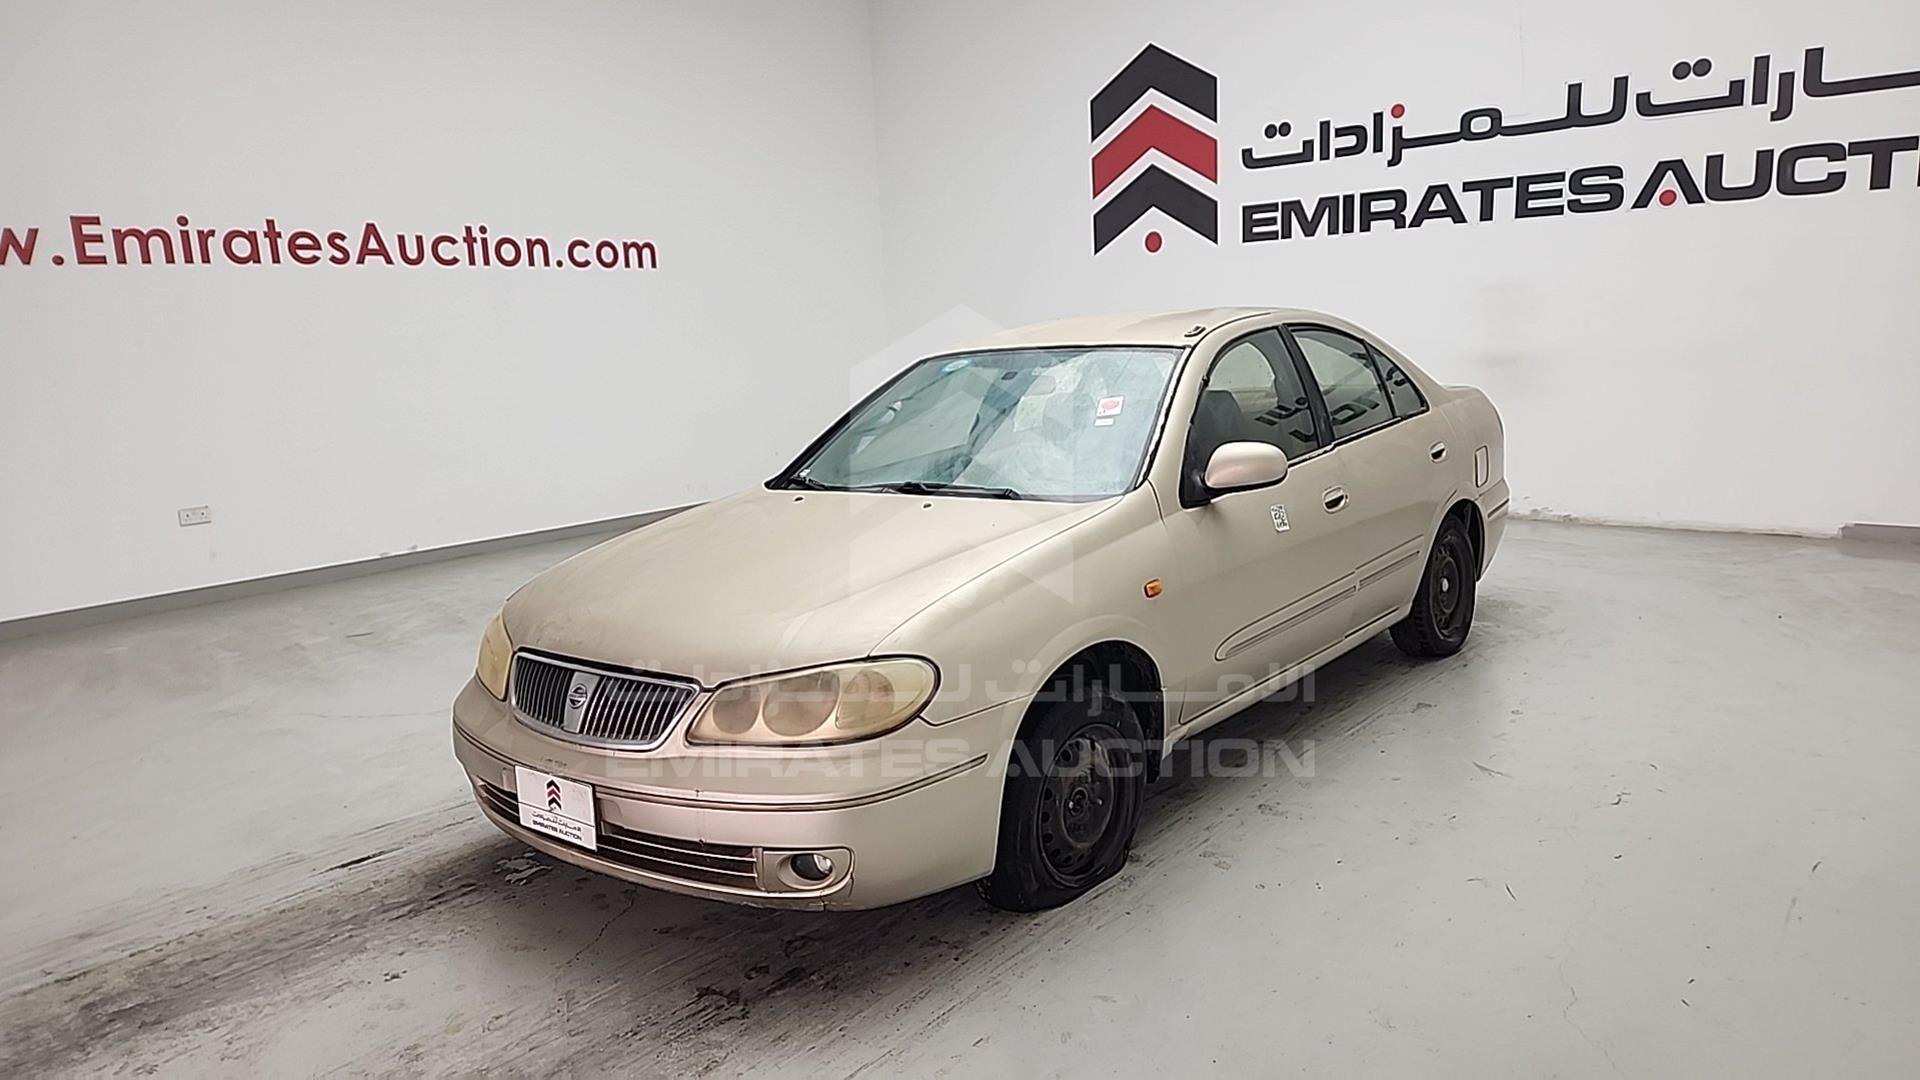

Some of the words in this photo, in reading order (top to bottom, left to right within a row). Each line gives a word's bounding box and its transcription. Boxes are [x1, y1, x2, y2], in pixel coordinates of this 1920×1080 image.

[1242, 75, 1629, 170] للمزادات
[1242, 165, 1624, 243] EMIRATES
[1630, 135, 1920, 209] AUCT
